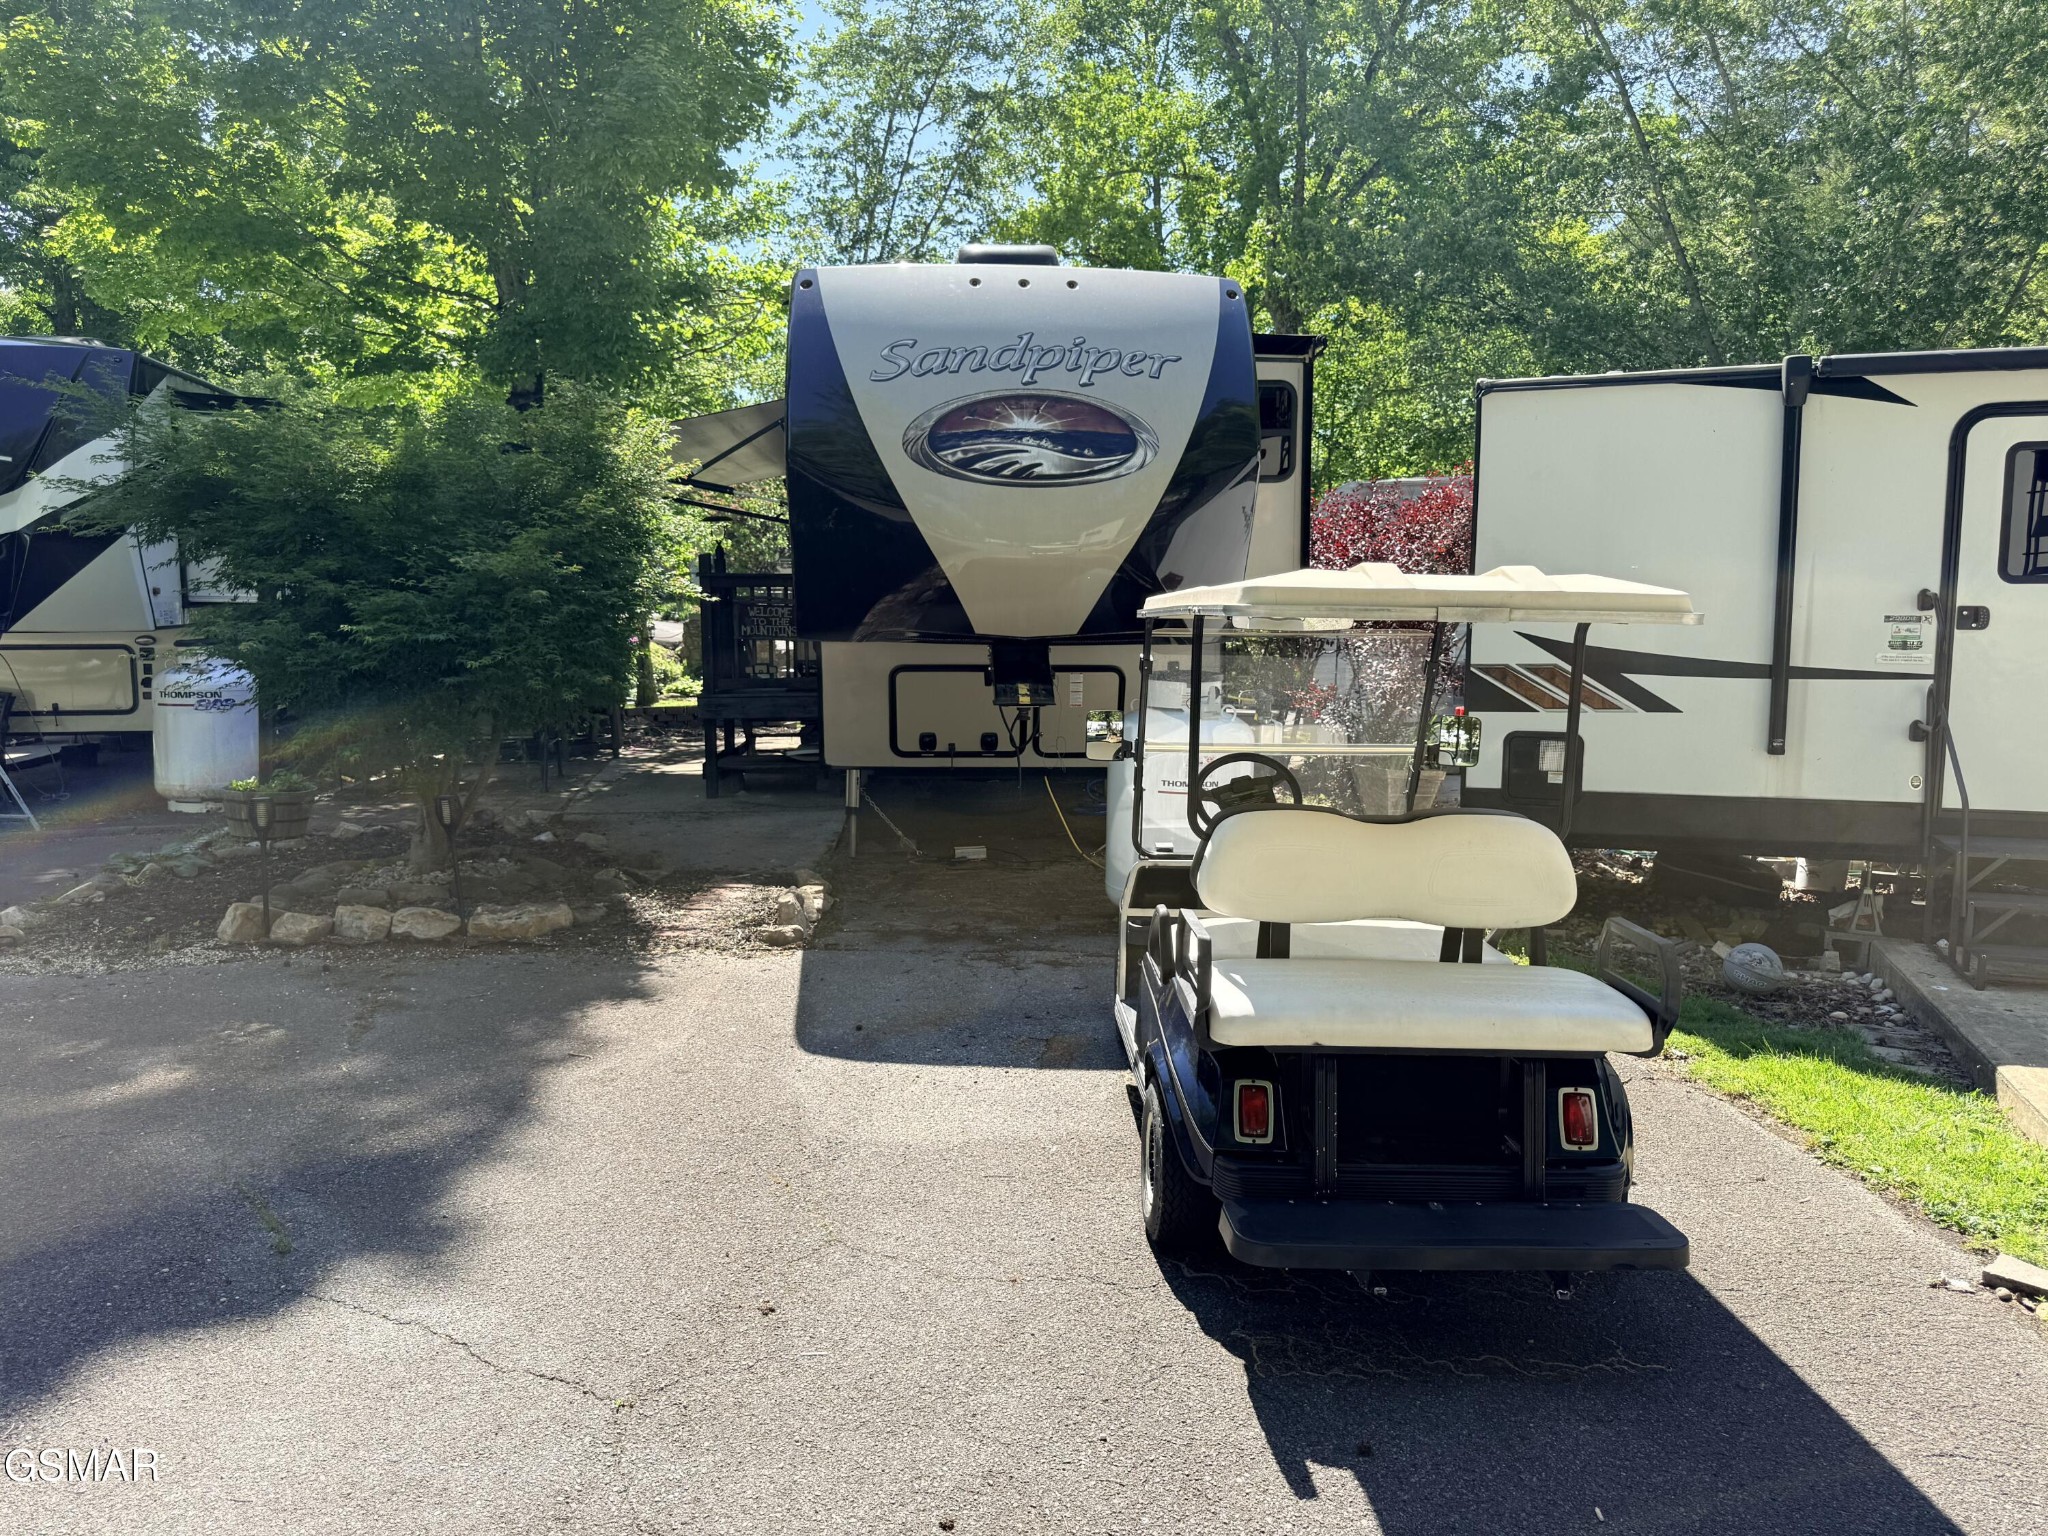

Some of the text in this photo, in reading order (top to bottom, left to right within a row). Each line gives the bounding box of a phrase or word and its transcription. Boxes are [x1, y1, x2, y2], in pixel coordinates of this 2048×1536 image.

[869, 331, 1183, 387] Sandpiper
[747, 606, 793, 618] WELCOME
[752, 617, 791, 626] TO THE
[741, 624, 798, 638] MOUNTAINS
[159, 690, 222, 699] THOMPSON
[1161, 780, 1219, 788] THOMON
[1734, 970, 1767, 988] SHAQ
